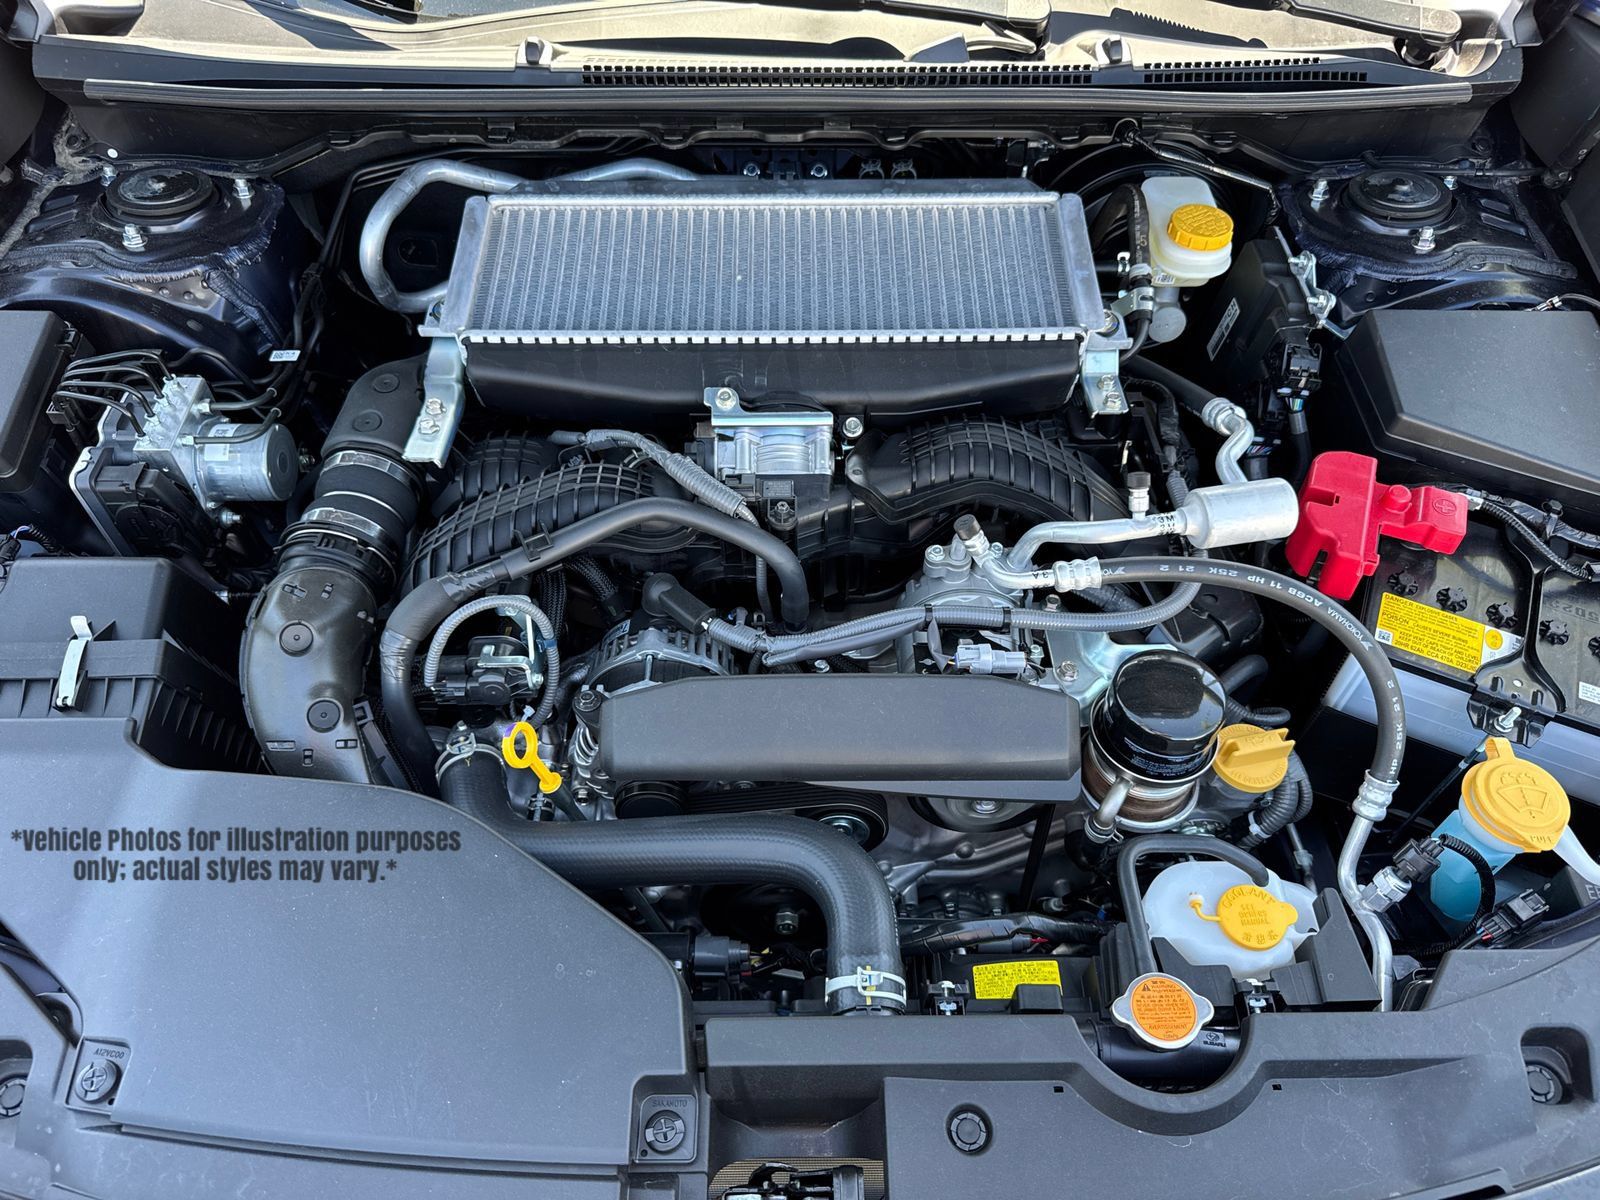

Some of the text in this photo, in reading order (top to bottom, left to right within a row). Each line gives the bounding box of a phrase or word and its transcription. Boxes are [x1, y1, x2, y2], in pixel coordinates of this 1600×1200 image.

[1159, 564, 1170, 572] 2
[1178, 564, 1196, 573] 21
[1208, 566, 1239, 577] 25K
[1247, 575, 1265, 585] HP
[1269, 580, 1283, 590] 11
[1383, 593, 1414, 607] DANGER
[1327, 606, 1364, 641] YOKOHAMA
[1380, 611, 1410, 624] POISON
[1387, 680, 1395, 689] 2
[1392, 696, 1401, 712] 21
[1395, 722, 1403, 750] 25K
[1389, 758, 1398, 775] HP
[1222, 887, 1276, 908] COOLANT
